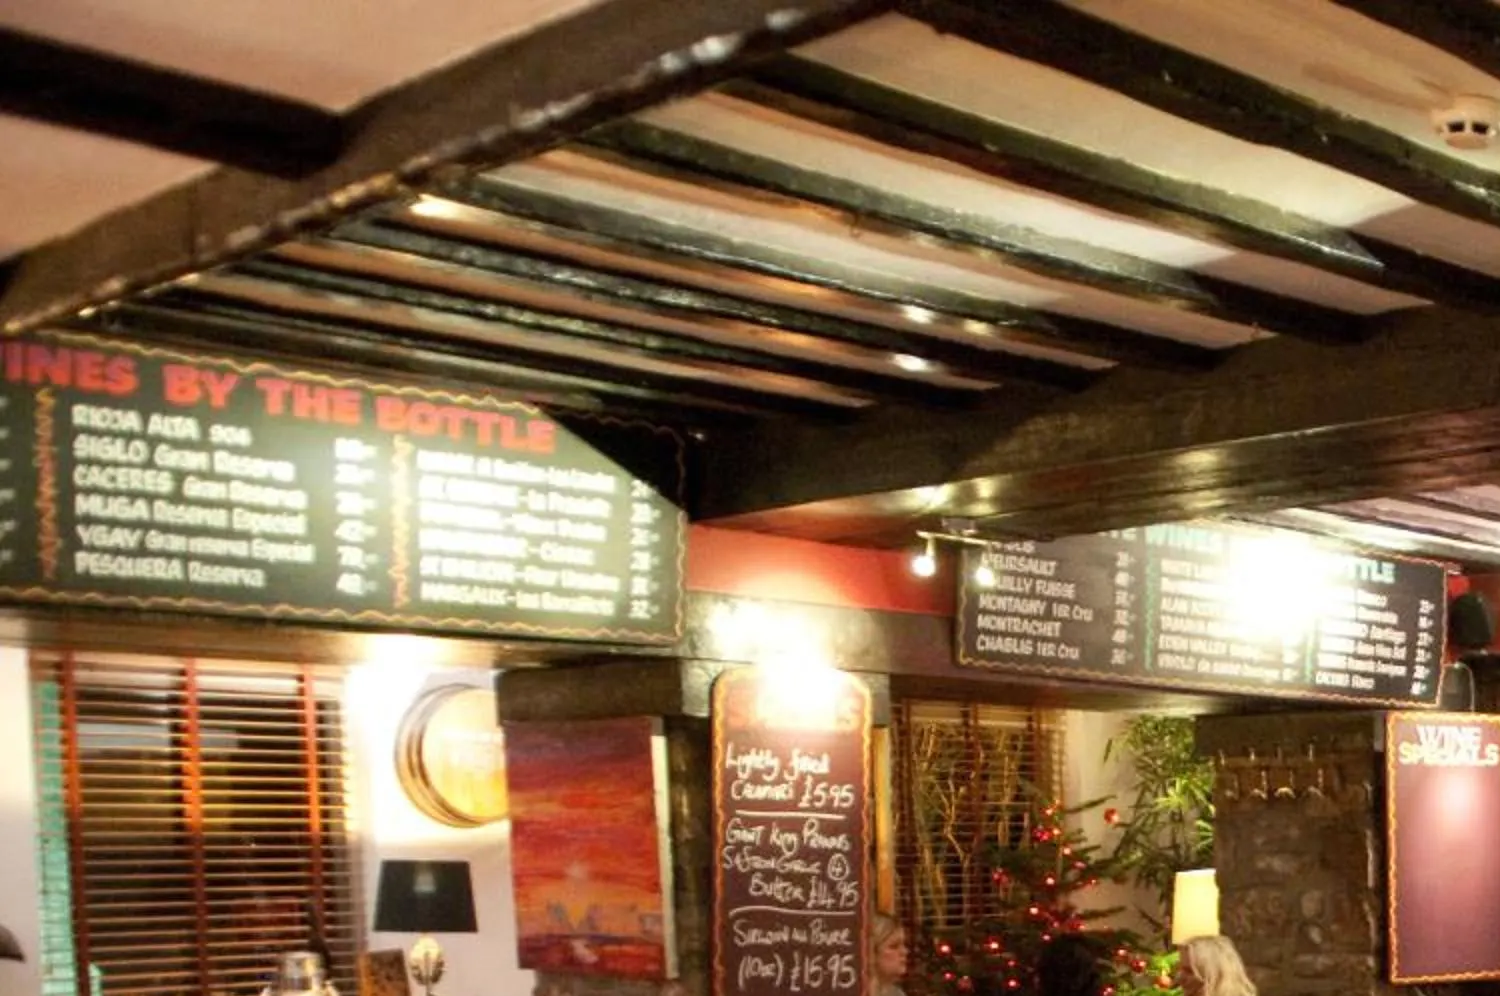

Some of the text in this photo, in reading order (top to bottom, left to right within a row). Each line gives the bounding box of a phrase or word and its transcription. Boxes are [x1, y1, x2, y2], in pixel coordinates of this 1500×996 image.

[0, 342, 557, 455] INES BY THE BOTTLE
[73, 433, 149, 463] SIGLO
[73, 465, 175, 494] CACERES
[74, 550, 185, 579] PESQUERA
[1416, 725, 1481, 748] WINE
[1399, 742, 1499, 766] SPECIALS
